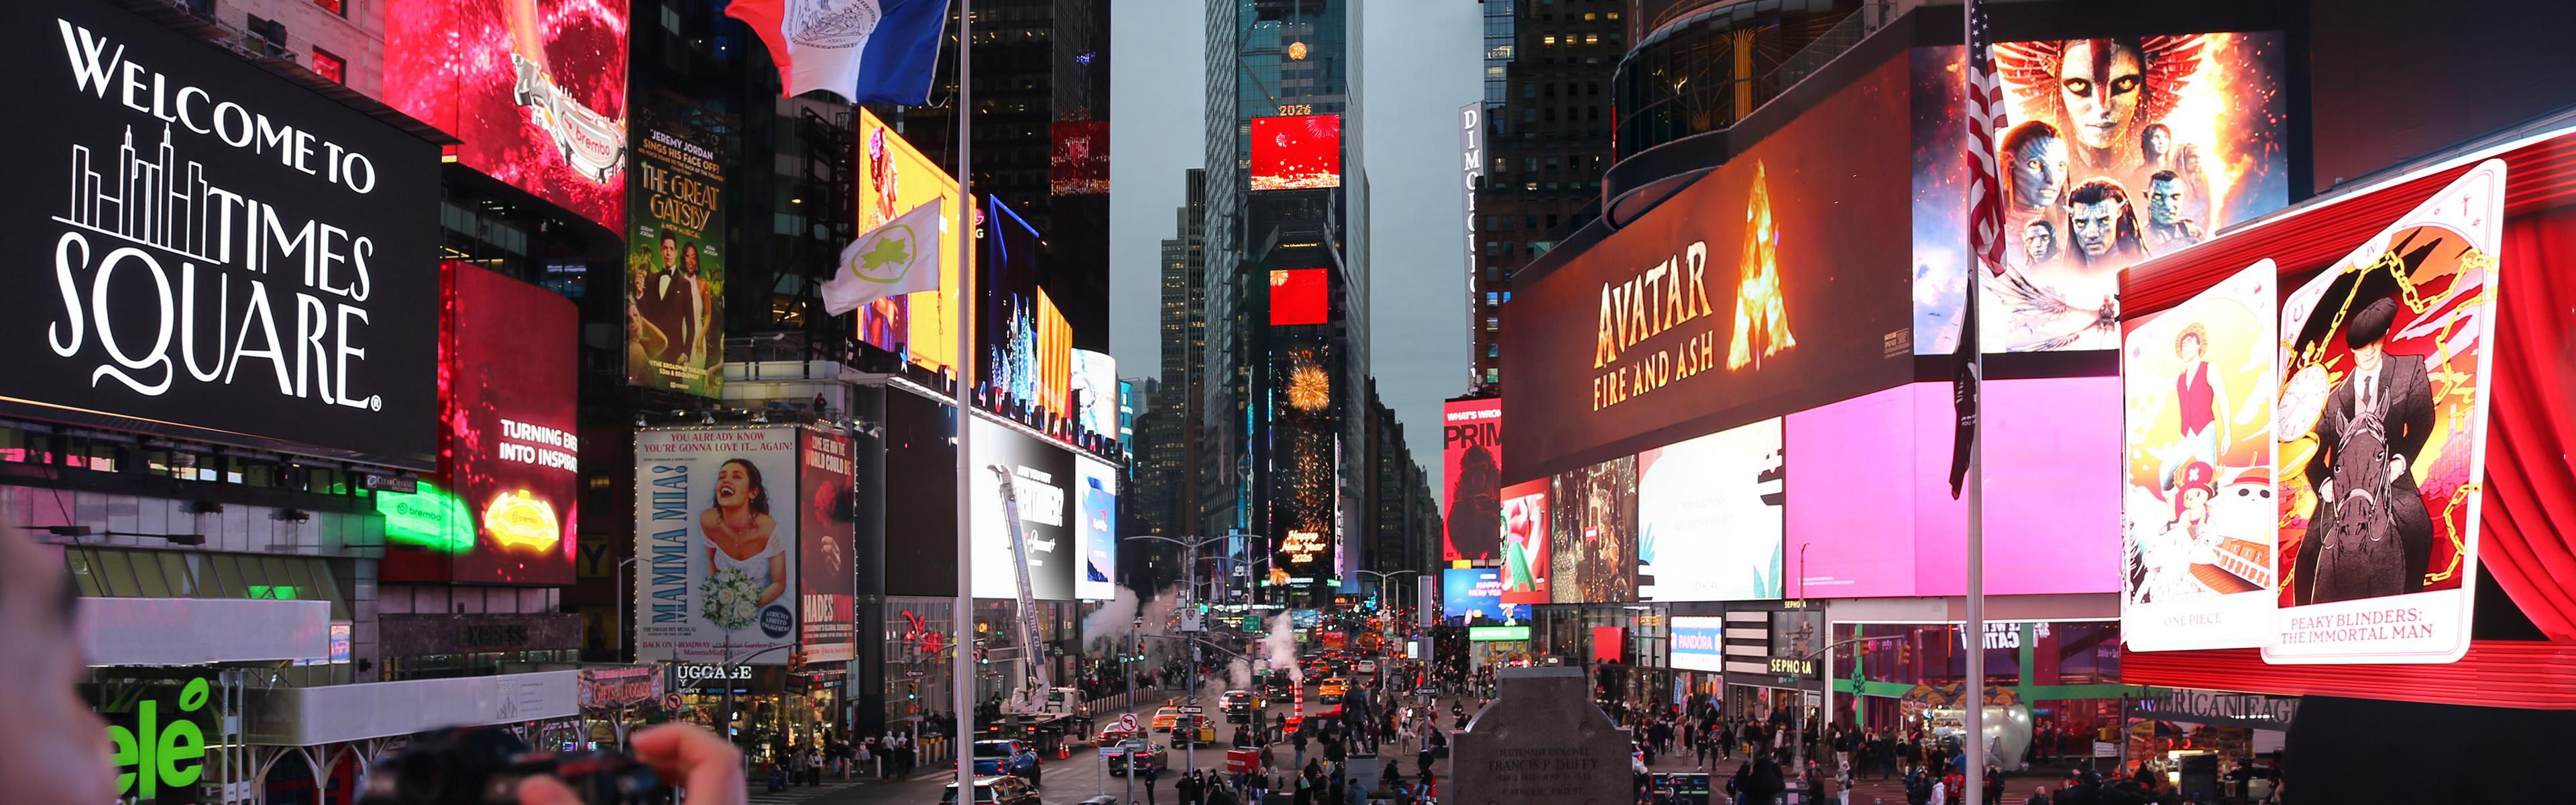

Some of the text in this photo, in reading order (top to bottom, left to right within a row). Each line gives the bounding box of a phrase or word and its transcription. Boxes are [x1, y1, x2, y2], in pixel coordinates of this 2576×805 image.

[58, 17, 376, 194] WELCOME TO
[1280, 104, 1311, 116] 2026
[576, 127, 611, 158] brembo
[643, 138, 667, 156] SINGS
[669, 149, 681, 160] HIS
[683, 154, 702, 168] FACE
[703, 161, 720, 174] OFF!
[683, 143, 713, 160] JORDAN
[685, 162, 694, 172] BACK
[643, 165, 720, 211] THE GREAT
[650, 194, 710, 231] GATSBY
[665, 223, 677, 231] NEW
[679, 228, 701, 239] MUSICAL
[208, 186, 373, 302] TIMES
[1593, 240, 1714, 369] AVATAR
[663, 362, 687, 372] BROADWAY
[1593, 330, 1714, 412] FIRE AND ASH
[1447, 411, 1477, 421] WHAT'S
[500, 419, 562, 447] TURNING
[671, 432, 766, 442] YOU ALREADY KNOW
[500, 442, 536, 464] INTO
[644, 443, 676, 453] YOU'RE
[679, 443, 712, 452] GONNA
[715, 443, 738, 451] LOVE
[760, 441, 793, 451] AGAIN!
[805, 449, 852, 476] WORLD COULD BE
[651, 465, 689, 521] MIA!
[409, 506, 442, 522] brembo
[1287, 529, 1319, 542] Happy
[1280, 540, 1326, 553] New Year
[1291, 553, 1313, 563] 2026
[652, 527, 688, 625] MAMMA
[1475, 581, 1502, 590] HAPPY
[1784, 600, 1807, 608] SEPHOA
[765, 617, 787, 626] LIMITED
[766, 610, 789, 620] STRICTLY
[1025, 594, 1037, 634] ELECTRIC
[1032, 635, 1040, 650] CO.
[2164, 613, 2222, 627] ONE PIECE
[2291, 608, 2423, 630] PEAKY BLINDERS:
[761, 622, 790, 633] ENGAGEMENT
[2281, 624, 2433, 644] THE IMMORTAL MAN
[461, 626, 527, 647] EXPRESS
[677, 666, 752, 679] UGGAGE
[594, 682, 615, 704] GIFTS
[2133, 687, 2237, 718] AMERICAN
[1496, 747, 1589, 757] LIEUTENANT COLONEL
[1488, 759, 1540, 771] FRANCIS
[1556, 759, 1598, 771] DUFFY
[1495, 774, 1512, 782] MAY
[1503, 787, 1583, 796] CATHOLIC PRIEST
